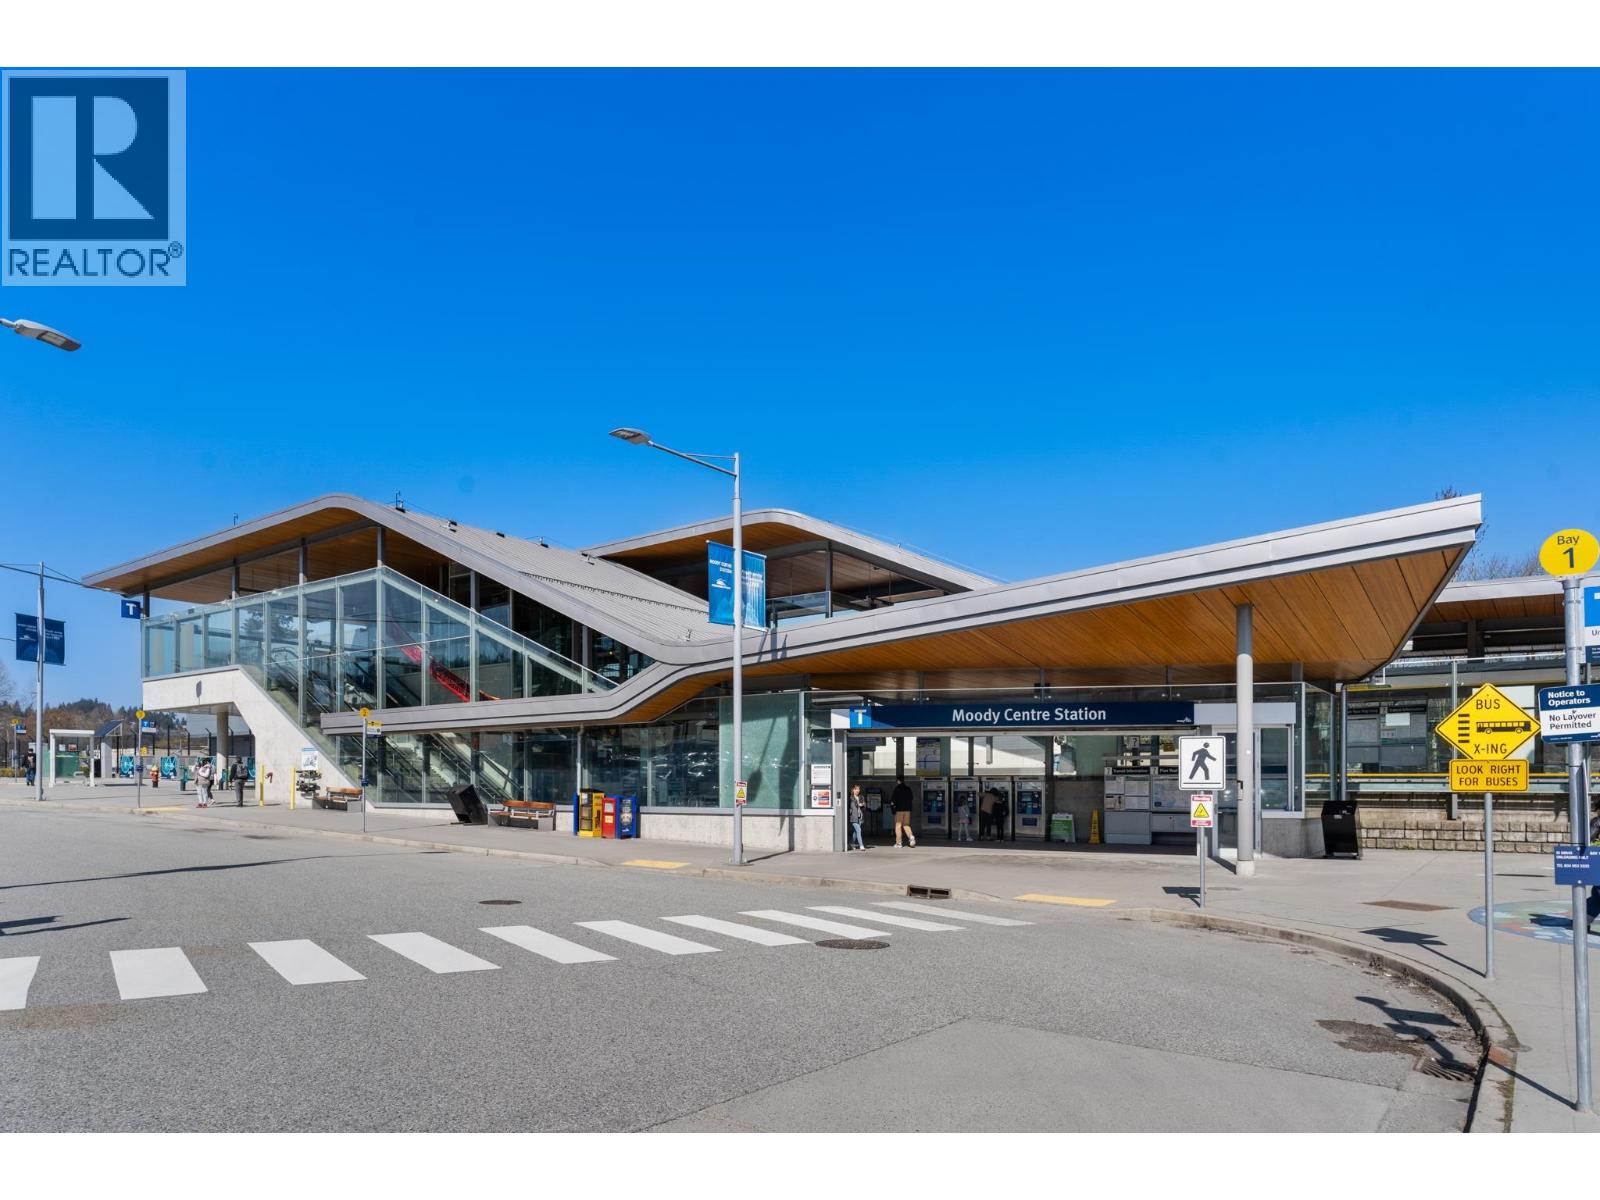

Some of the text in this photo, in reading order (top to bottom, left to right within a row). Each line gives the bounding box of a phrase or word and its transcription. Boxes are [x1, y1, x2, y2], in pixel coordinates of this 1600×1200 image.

[1557, 535, 1580, 545] Bay
[1562, 547, 1575, 569] 1
[126, 603, 136, 615] T
[1547, 689, 1586, 699] Notice to
[1475, 698, 1501, 710] BUS
[1548, 697, 1591, 708] Operators
[854, 709, 867, 725] T
[952, 707, 1107, 724] Moody Centre Station
[1549, 712, 1597, 722] No Layover
[1549, 720, 1592, 730] Permitted
[1473, 743, 1508, 755] X-ING
[1456, 764, 1522, 775] LOOK RIGHT
[1459, 776, 1519, 787] FOR BUSES
